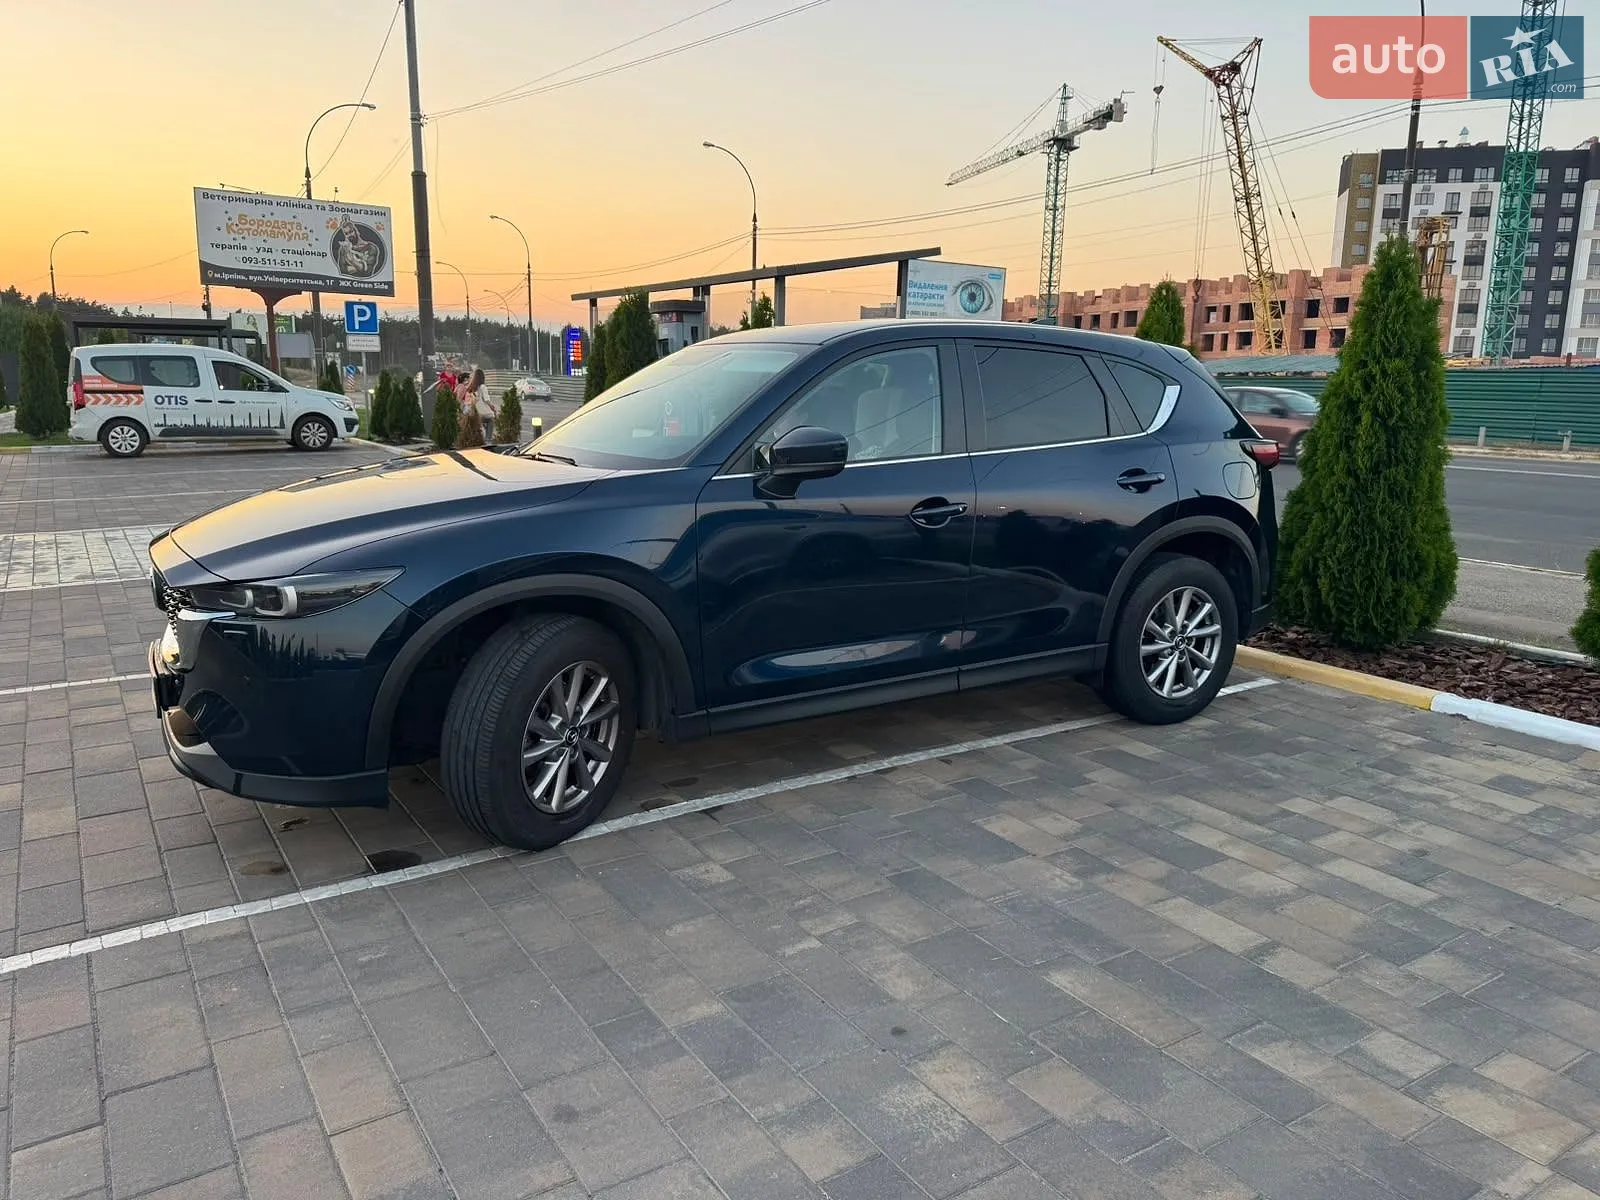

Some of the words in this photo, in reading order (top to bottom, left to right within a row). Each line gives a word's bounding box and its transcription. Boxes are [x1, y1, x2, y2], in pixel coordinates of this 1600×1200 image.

[202, 191, 273, 206] Ветеринарна
[276, 199, 313, 210] клініка
[328, 204, 386, 217] Зоомагазин
[237, 213, 303, 231] Бородата
[225, 222, 309, 241] Котомамуля
[210, 242, 247, 252] терапія
[281, 247, 328, 259] стаціонар
[241, 256, 304, 268] 093-511-51-11
[373, 282, 389, 290] Side
[908, 280, 948, 291] Видалення
[908, 291, 945, 301] катаракти
[353, 304, 371, 330] P
[154, 394, 189, 406] OTIS
